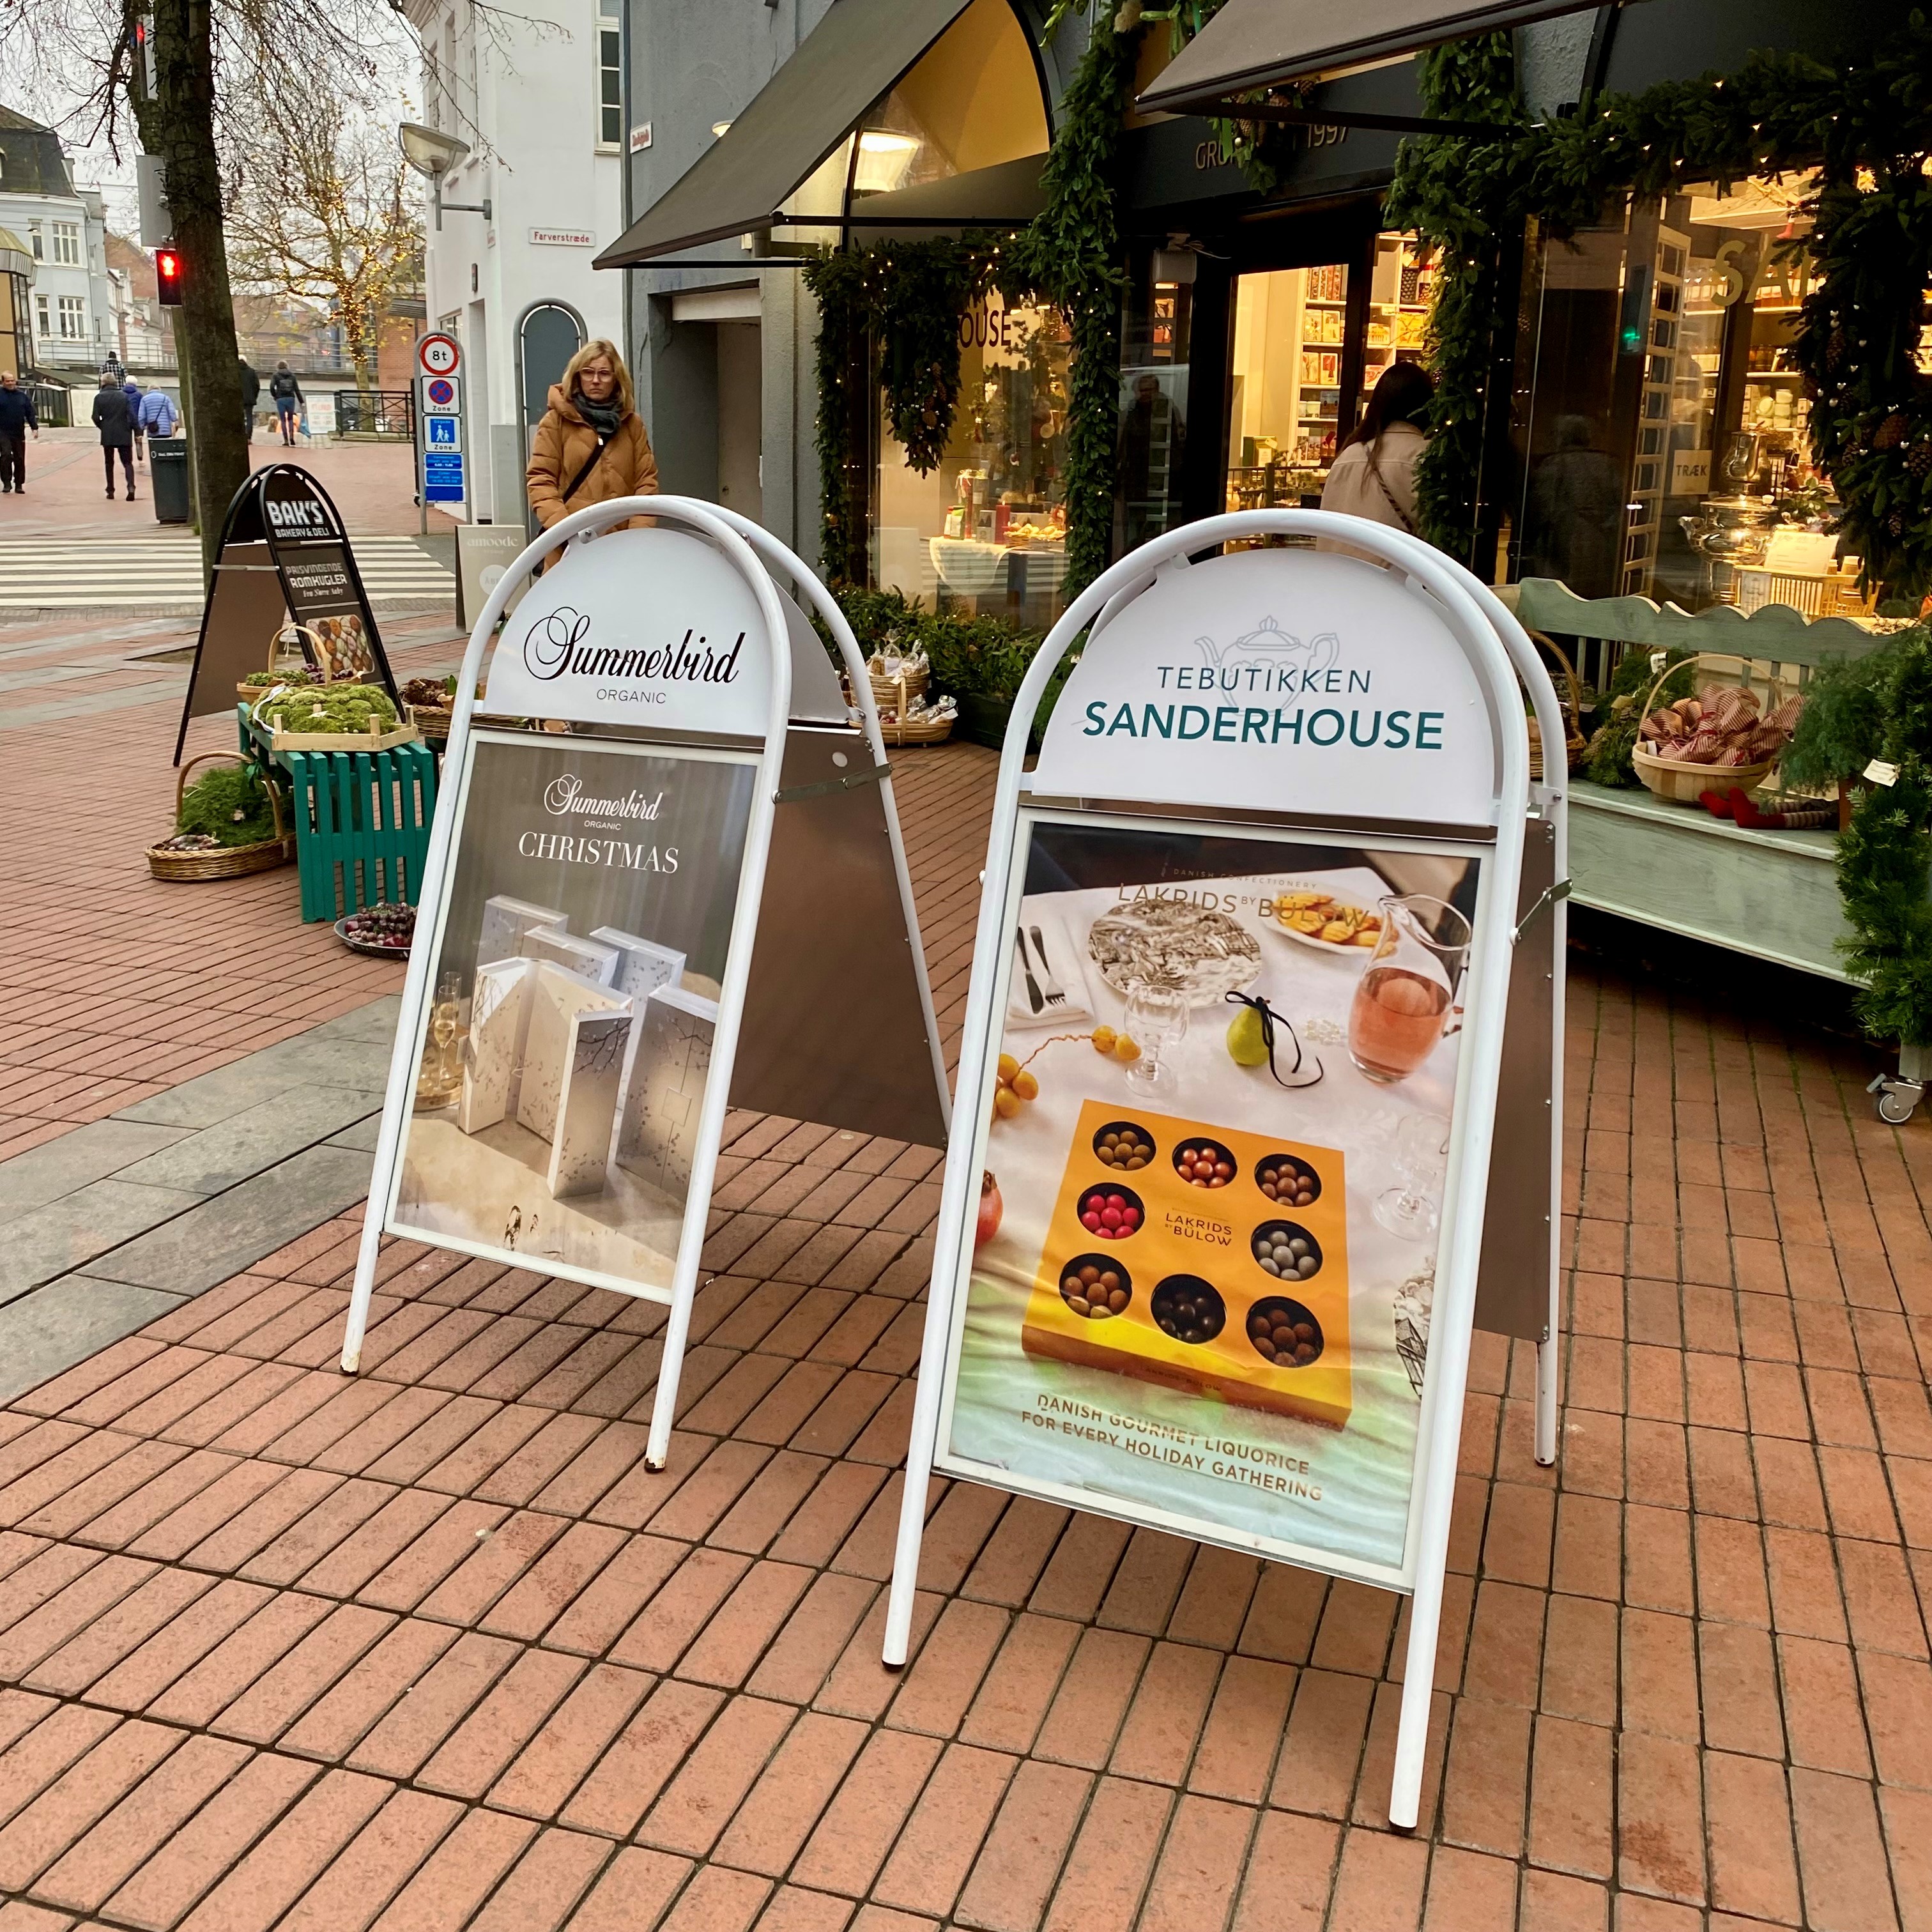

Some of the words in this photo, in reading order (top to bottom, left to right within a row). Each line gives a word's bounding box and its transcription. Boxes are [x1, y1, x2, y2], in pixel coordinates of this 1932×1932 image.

[534, 231, 590, 243] Farverstræde
[959, 310, 1011, 348] OUSE
[1676, 464, 1708, 476] TRÆK
[265, 500, 325, 526] BAK'S
[289, 574, 348, 588] ROMKUGLER
[523, 606, 746, 684] Summerbird
[1157, 666, 1371, 693] TEBUTIKKEN
[596, 688, 667, 704] ORGANIC
[1082, 701, 1445, 750] SANDERHOUSE
[544, 774, 663, 820] Summerbird
[584, 820, 622, 831] ORGANIC
[518, 831, 679, 874] CHRISTMAS
[1174, 868, 1214, 878] DANISH
[1220, 873, 1317, 889] CONFECTIONERY
[1118, 882, 1237, 914] LAKRIDS
[1241, 896, 1257, 906] BY
[1258, 896, 1370, 928] BÜLOW
[1166, 1213, 1232, 1235] LAKRIDS
[1174, 1225, 1232, 1246] BÜLOW
[1038, 1393, 1103, 1423] DANISH
[1110, 1413, 1200, 1446] GOURMET
[1205, 1436, 1310, 1475] LIQUORICE
[1022, 1411, 1055, 1431] FOR
[1062, 1422, 1120, 1447] EVERY
[1124, 1438, 1206, 1470] HOLIDAY
[1211, 1460, 1322, 1501] GATHERING
